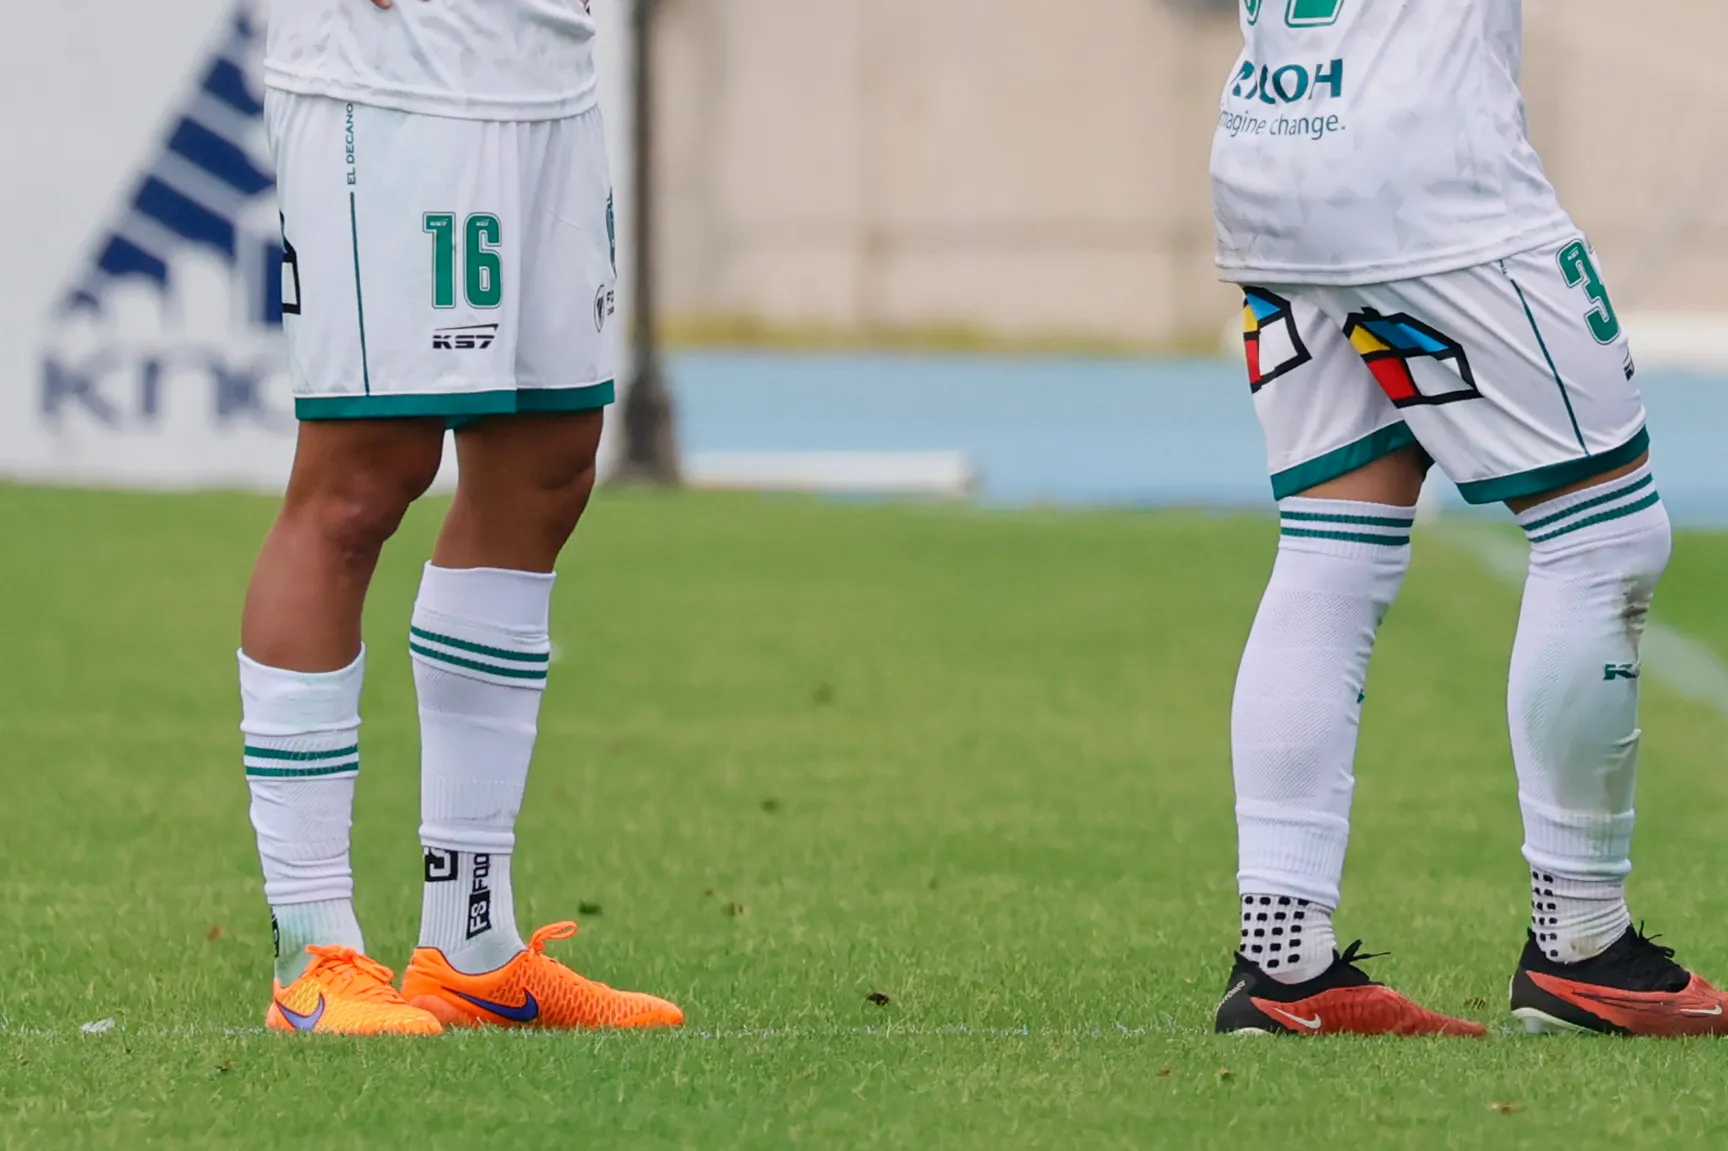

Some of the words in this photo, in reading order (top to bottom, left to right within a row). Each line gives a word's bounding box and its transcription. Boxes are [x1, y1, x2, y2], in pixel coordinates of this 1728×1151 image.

[346, 103, 355, 164] DECANO
[1220, 109, 1266, 138] magine
[1269, 114, 1346, 141] change.
[347, 166, 356, 185] EL
[422, 211, 502, 309] 16
[469, 901, 487, 934] FS
